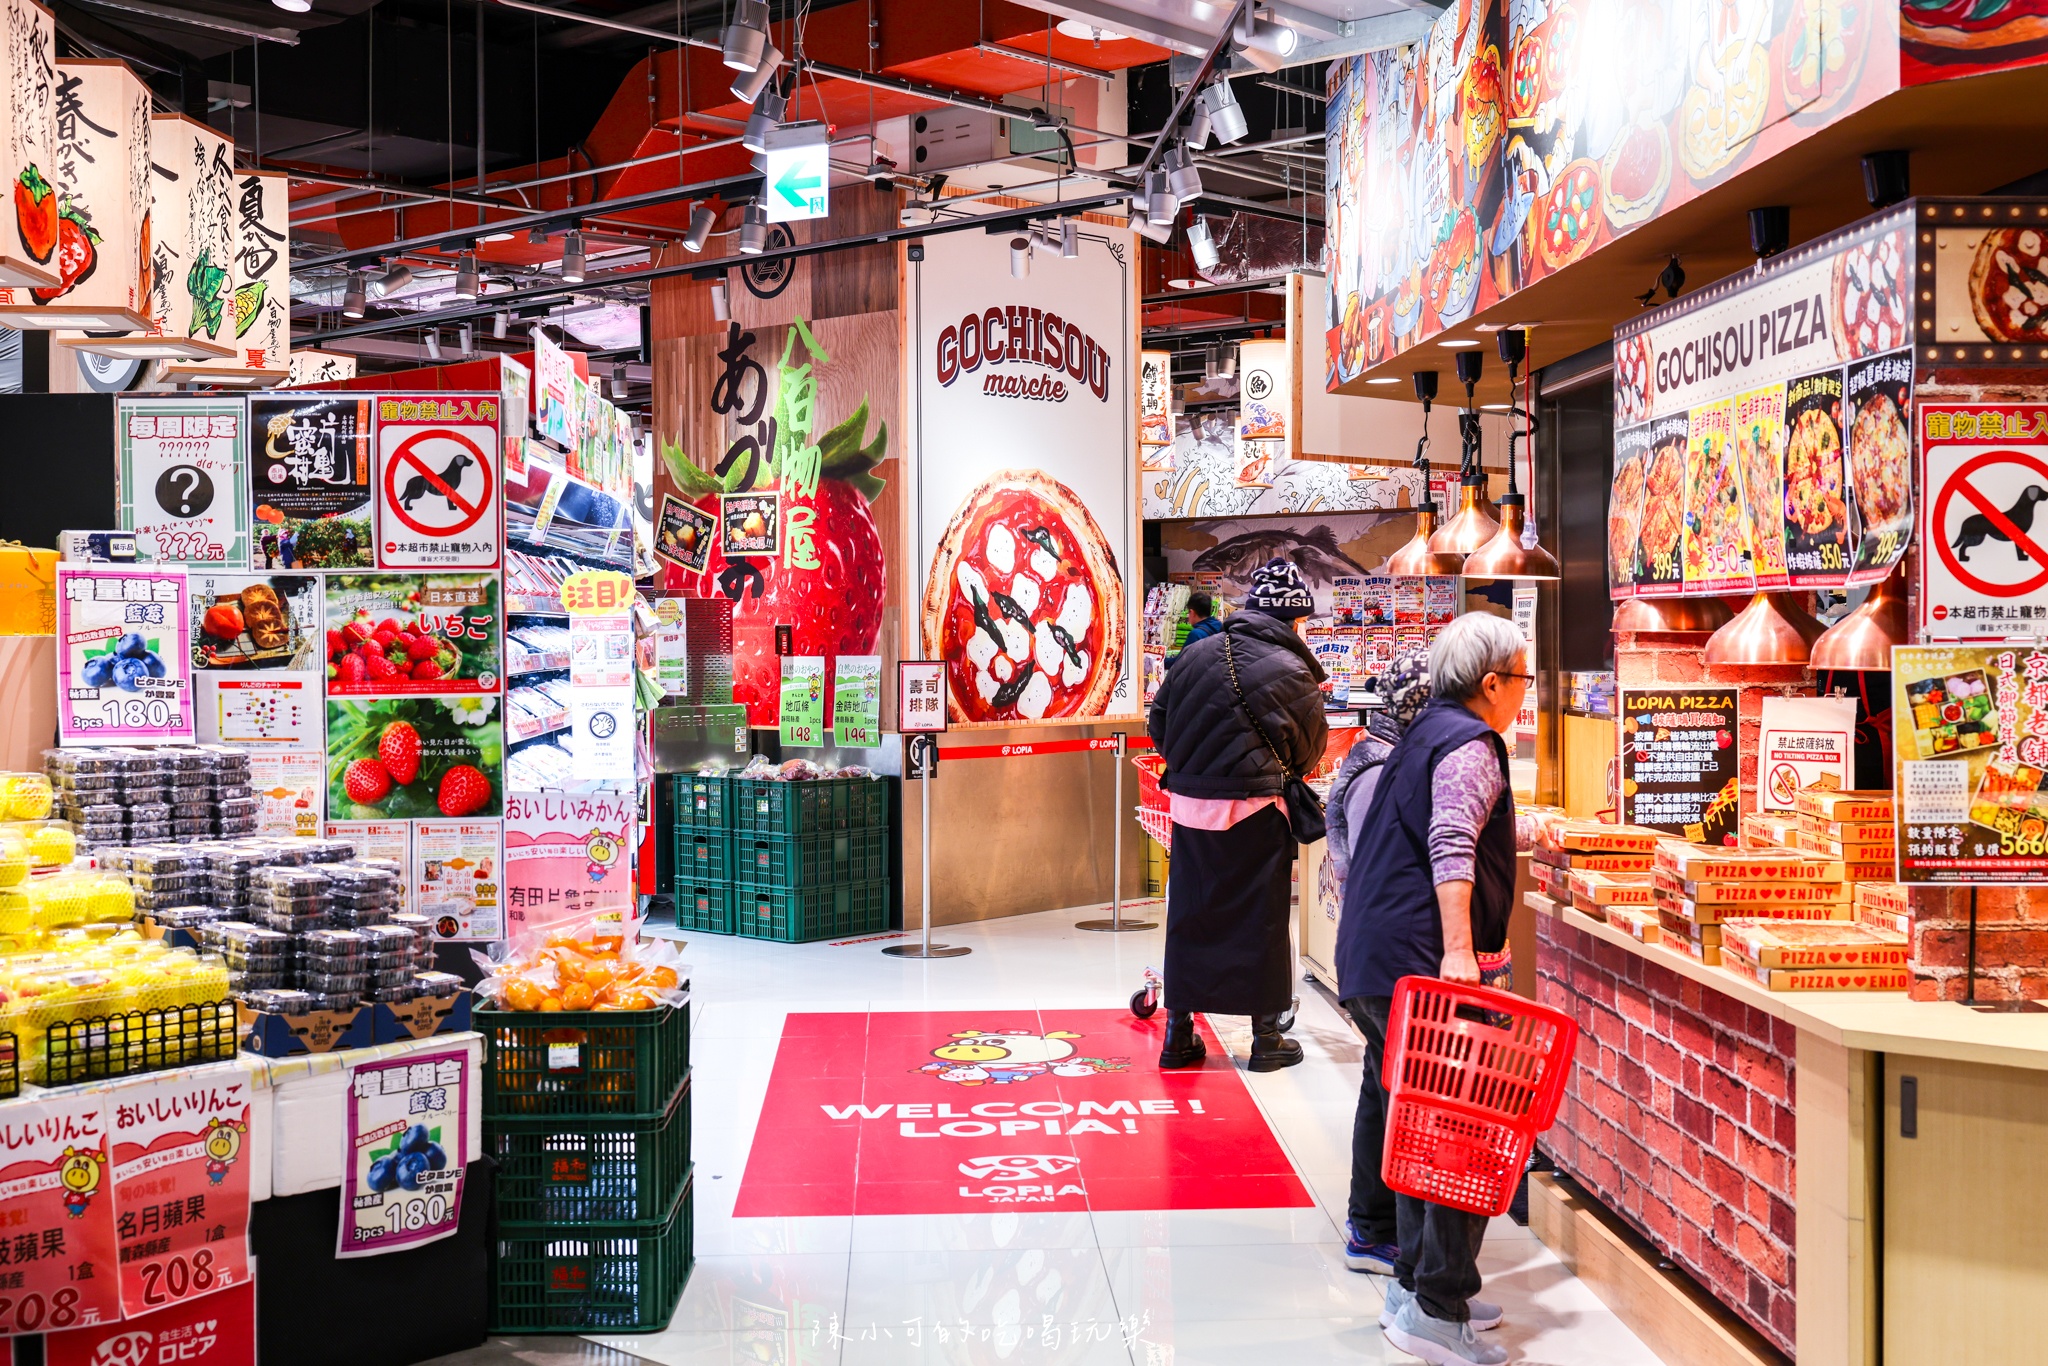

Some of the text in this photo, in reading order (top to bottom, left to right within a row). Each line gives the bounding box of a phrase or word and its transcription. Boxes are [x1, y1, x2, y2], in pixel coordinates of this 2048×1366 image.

[1656, 293, 1828, 394] GOCHISOU PIZZA
[937, 305, 1110, 403] GOCHISOU
[983, 373, 1068, 403] marche
[379, 400, 497, 422] 寵物禁止入內
[112, 542, 134, 552] 展示品
[430, 591, 480, 603] 日本直送
[567, 578, 630, 609] 注目!
[1258, 597, 1312, 608] EVISU
[124, 604, 164, 624] 藍莓
[418, 612, 493, 640] いちご
[782, 664, 820, 674] 自然のおやつ
[837, 664, 876, 674] 自然のおやつ
[135, 677, 184, 688] ビタミンE
[909, 679, 939, 694] 壽司
[785, 700, 809, 713] 地瓜條
[835, 700, 869, 713] 金時地瓜
[909, 697, 939, 712] 排隊
[1627, 695, 1734, 710] LOPIA PIZZA
[72, 717, 103, 729] 3pcs
[809, 717, 821, 725] 1pcs
[864, 717, 877, 725] 1pcs
[1012, 745, 1033, 754] LOPIA
[1777, 736, 1835, 750] 禁止披薩斜放
[1784, 752, 1806, 760] TILTING
[506, 795, 631, 823] おいしいみかん
[1851, 807, 1890, 818] PIZZA
[1907, 826, 1960, 839] 數量限定
[1580, 837, 1613, 848] PIZZA
[1908, 843, 1960, 857] 預約販售
[1585, 859, 1619, 869] PIZZA
[1705, 866, 1825, 878] PIZZA ENJOY
[1854, 867, 1892, 878] PIZZA
[1612, 891, 1648, 901] PIZZA
[1716, 888, 1833, 900] PIZZA ENJOY
[1863, 893, 1881, 907] PIZZA
[1787, 909, 1832, 921] ENJOY
[1781, 951, 1826, 964] PIZZA
[1790, 976, 1835, 988] PIZZA
[409, 1088, 446, 1114] 藍莓
[900, 1118, 1140, 1138] LOPIA!
[416, 1167, 463, 1182] ビタミンE
[119, 1176, 177, 1203] 旬の味覚!
[959, 1184, 1088, 1198] LOPIA
[116, 1194, 206, 1241] 名月蘋果
[205, 1224, 227, 1242] 1盒
[354, 1226, 385, 1241] 3pcs
[68, 1261, 95, 1281] 1盒
